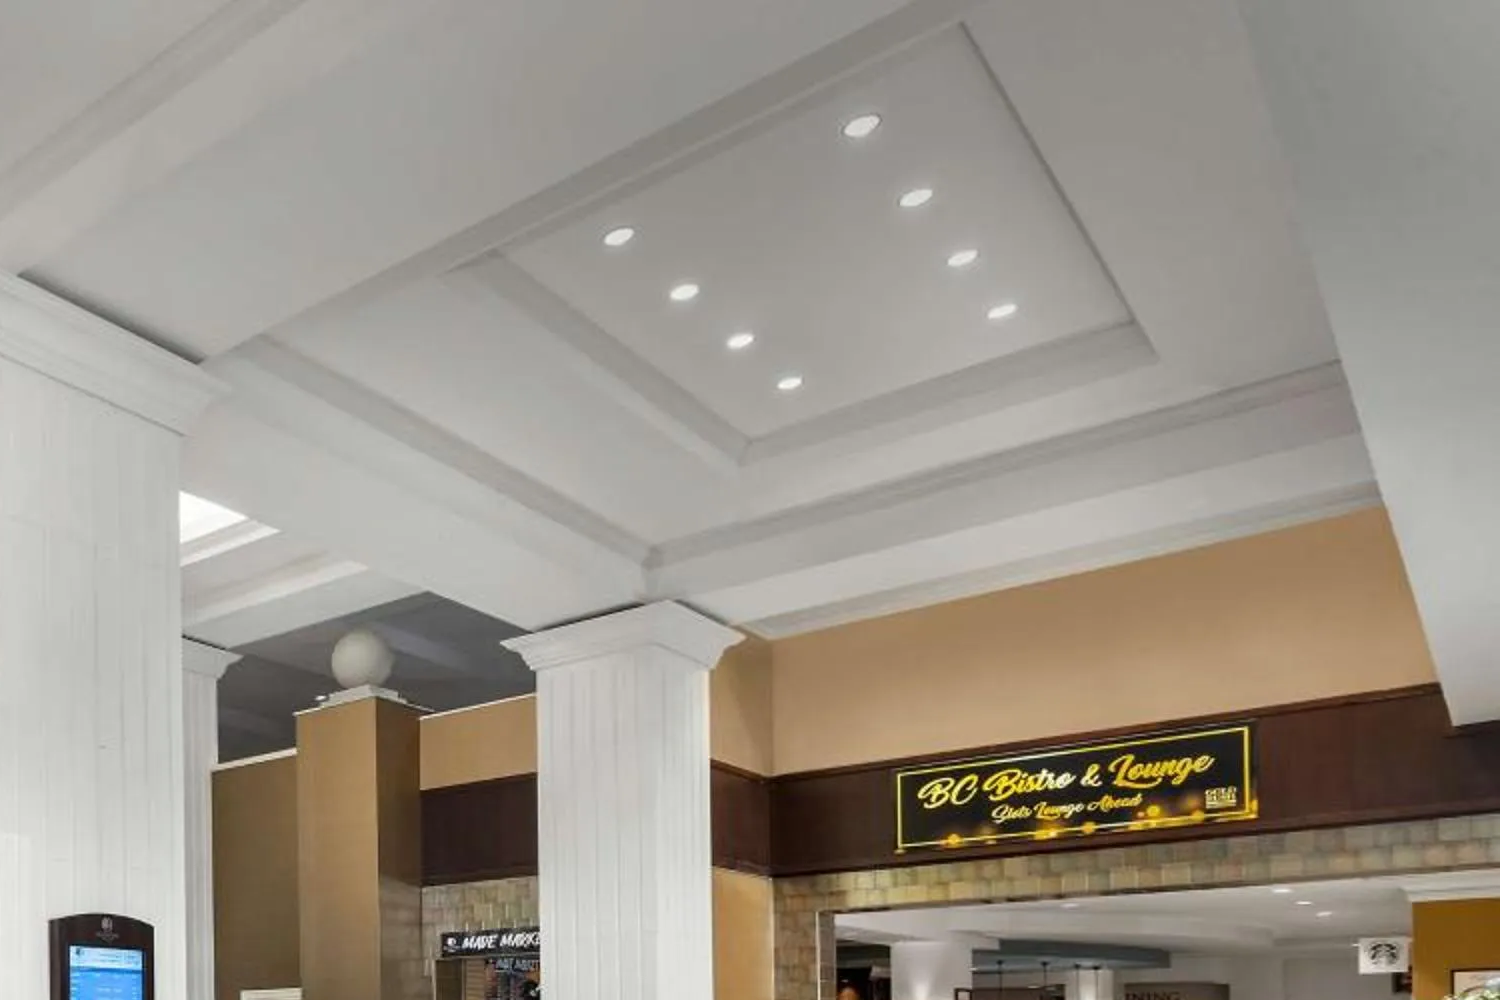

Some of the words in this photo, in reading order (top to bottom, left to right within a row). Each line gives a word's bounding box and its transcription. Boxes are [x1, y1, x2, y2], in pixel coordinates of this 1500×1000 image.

[917, 773, 979, 809] BC
[982, 768, 1077, 801] Bistro
[1080, 763, 1103, 787] &
[1108, 754, 1216, 789] Lounge
[1033, 801, 1085, 819] Lounge
